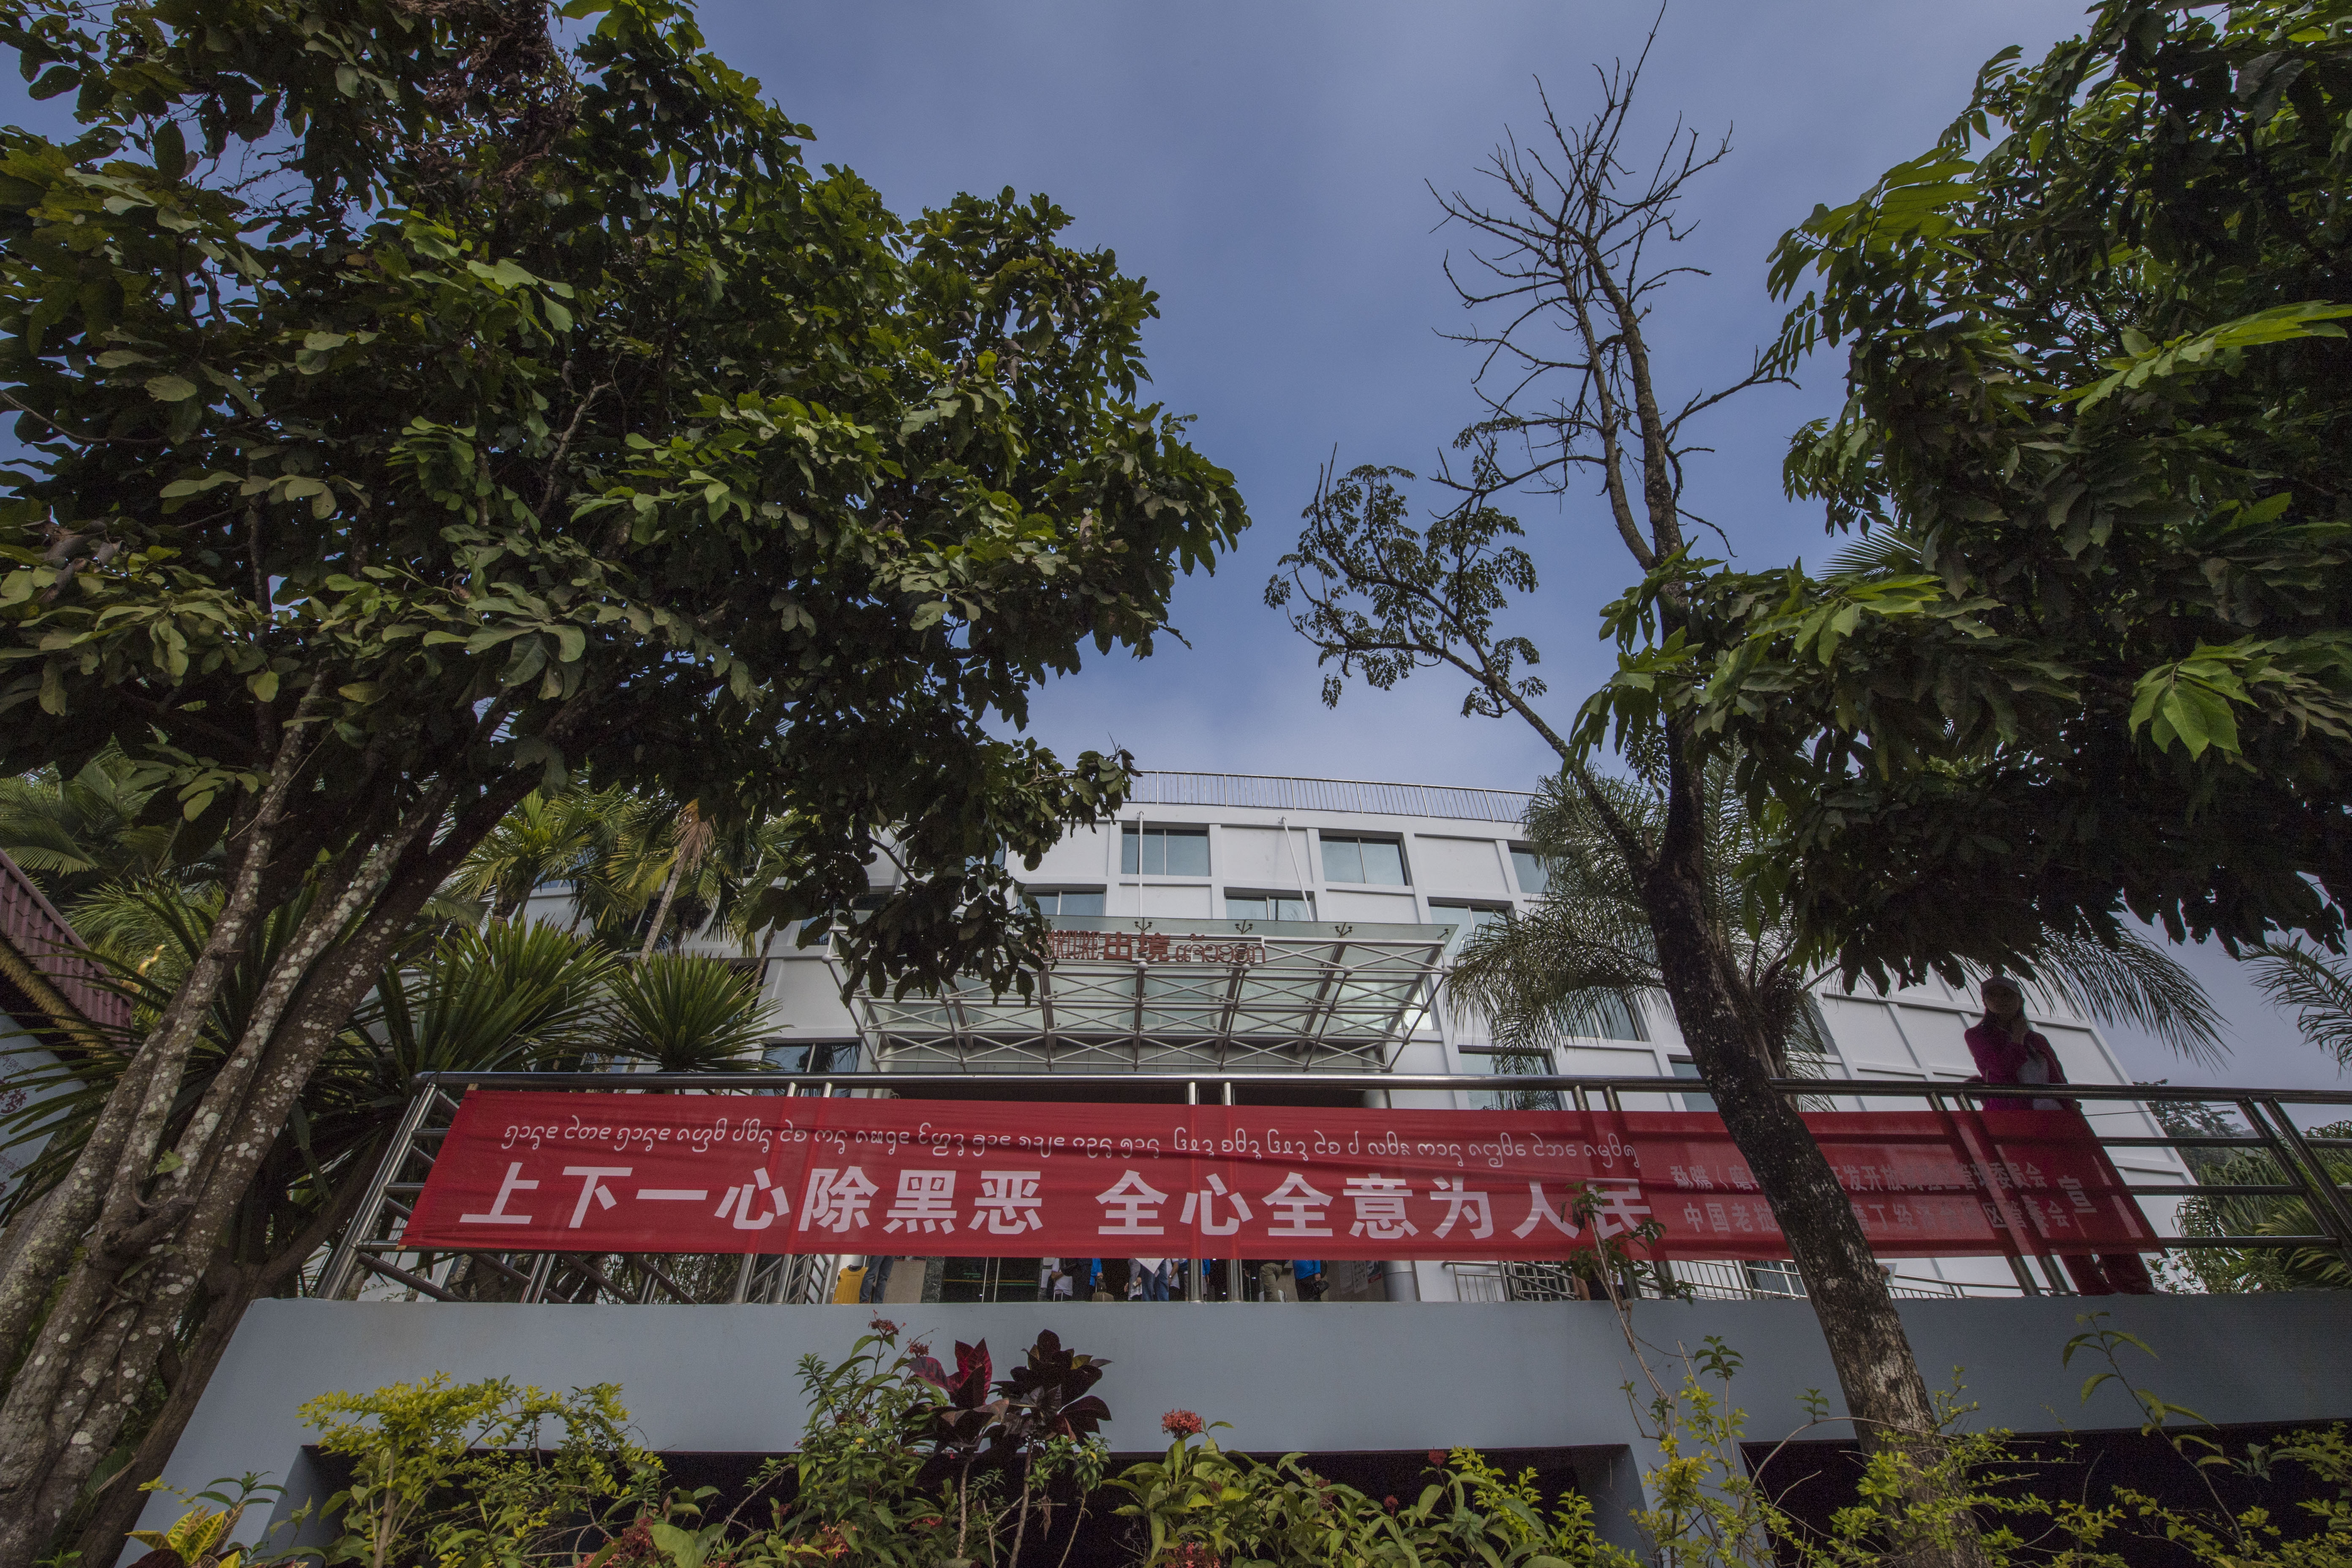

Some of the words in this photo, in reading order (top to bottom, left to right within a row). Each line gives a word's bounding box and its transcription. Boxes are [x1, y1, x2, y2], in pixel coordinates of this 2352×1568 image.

[1103, 932, 1170, 961] 出境
[459, 1162, 1043, 1235] 上下一心除黑恶
[1096, 1169, 1658, 1240] 全心全意为人民
[2057, 1175, 2098, 1213] 宣
